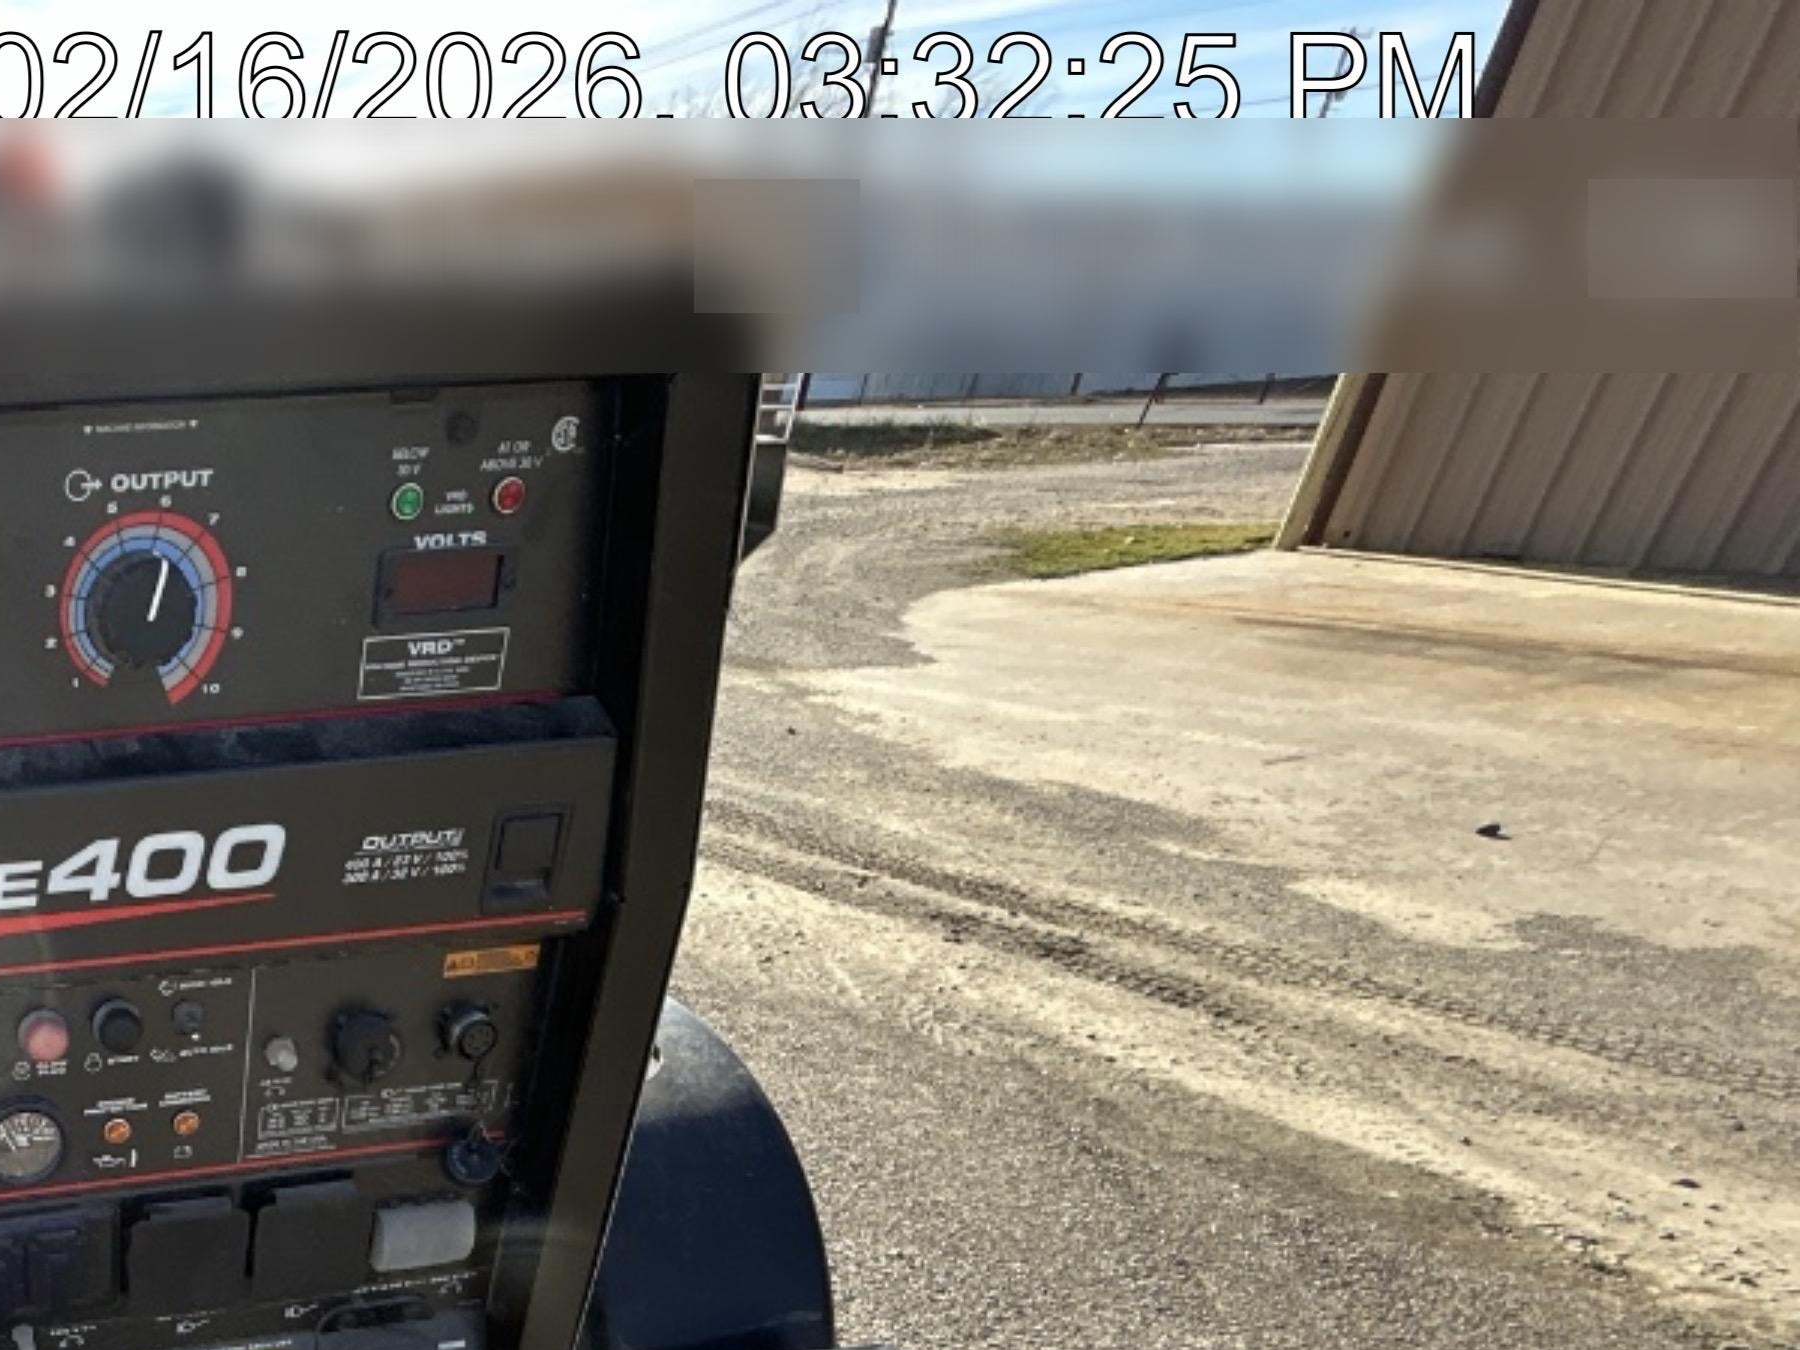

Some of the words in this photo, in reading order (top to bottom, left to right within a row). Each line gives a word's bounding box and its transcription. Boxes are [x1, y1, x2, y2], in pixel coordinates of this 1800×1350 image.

[110, 468, 214, 492] OUTPUT
[413, 531, 487, 550] VOLTS
[203, 682, 220, 694] 10
